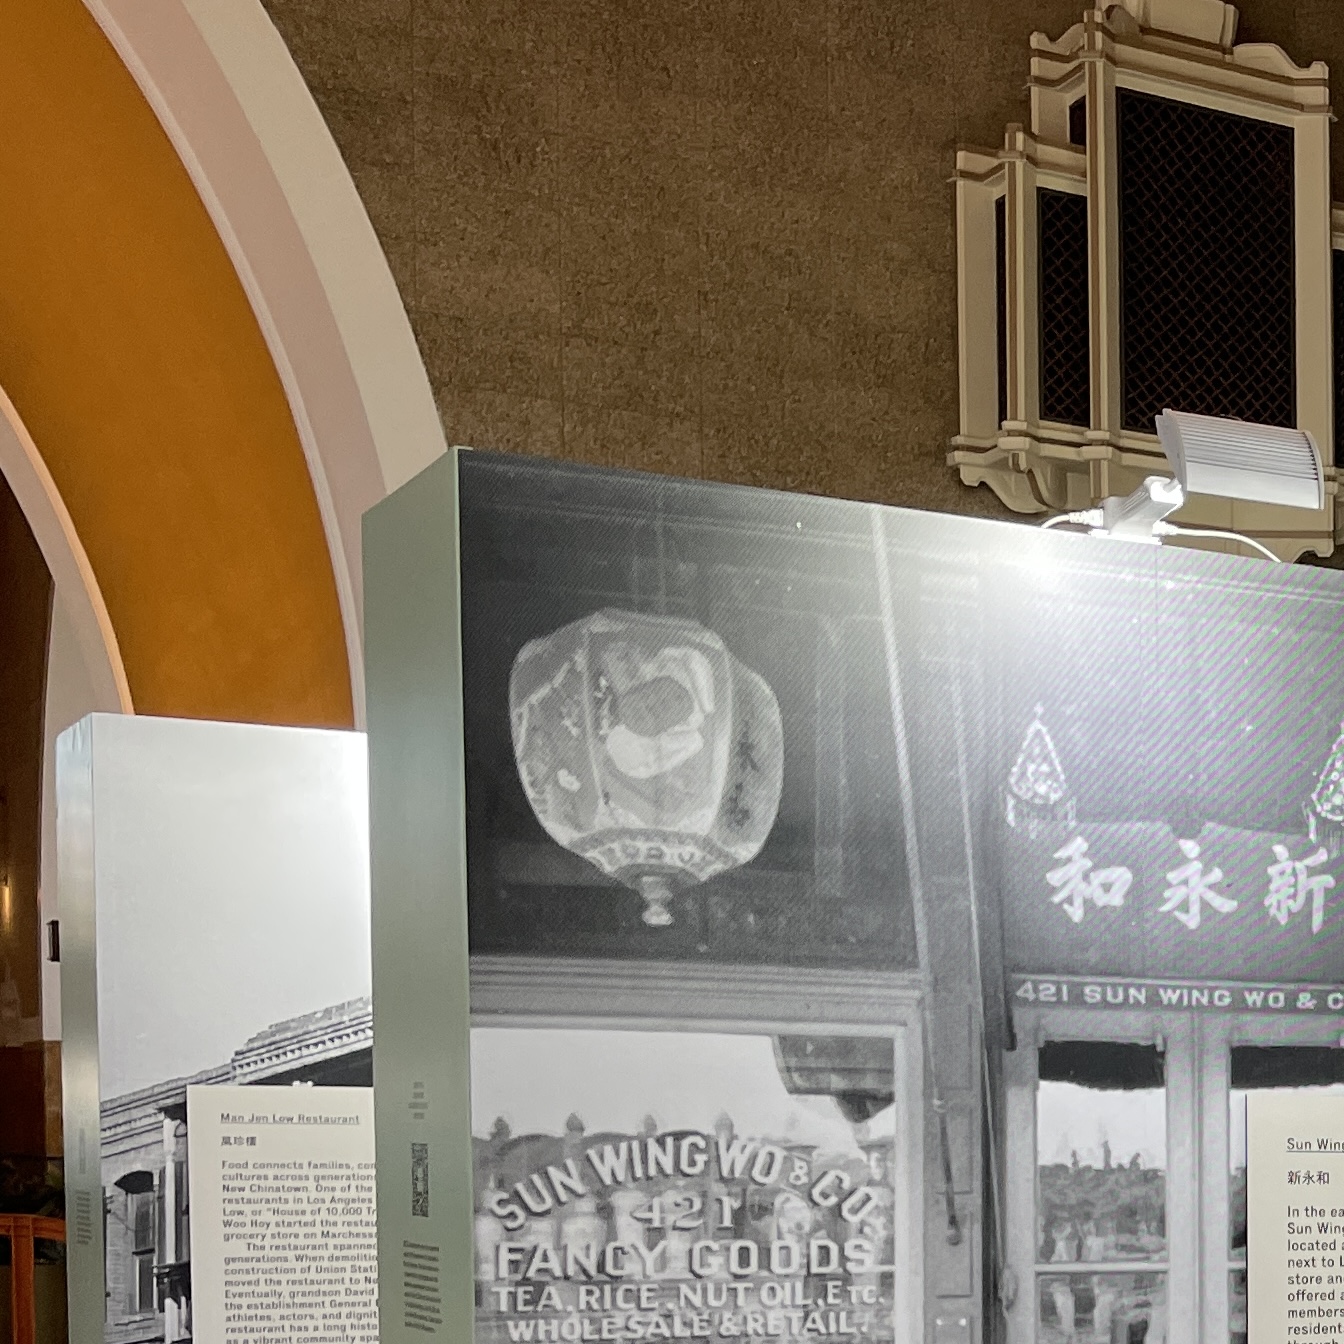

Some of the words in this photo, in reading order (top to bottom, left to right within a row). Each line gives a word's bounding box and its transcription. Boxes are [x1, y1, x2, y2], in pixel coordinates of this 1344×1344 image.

[1016, 980, 1069, 1002] 421
[1084, 983, 1146, 1006] SUN
[1159, 986, 1232, 1008] WING
[1244, 989, 1284, 1009] WO
[1296, 991, 1317, 1010] &
[220, 1113, 244, 1122] Man
[247, 1113, 268, 1122] Jen
[272, 1113, 294, 1122] Low
[297, 1114, 359, 1122] Restaurant
[1286, 1137, 1312, 1150] Sun
[221, 1160, 249, 1169] Food
[252, 1161, 304, 1169] connects
[307, 1160, 354, 1170] families,
[491, 1158, 587, 1231] SUN
[588, 1135, 709, 1187] WING
[716, 1137, 787, 1186] WO
[790, 1158, 809, 1187] &
[1287, 1170, 1330, 1185] 新永和
[222, 1183, 246, 1193] New
[249, 1183, 312, 1193] Chinatown.
[315, 1183, 337, 1193] One
[340, 1183, 351, 1193] of
[355, 1184, 373, 1192] the
[631, 1195, 742, 1231] 421
[1287, 1205, 1300, 1217] In
[1304, 1205, 1326, 1217] the
[1287, 1221, 1312, 1235] Sun
[1287, 1239, 1336, 1251] located
[497, 1239, 668, 1280] FANCY
[690, 1238, 873, 1277] GOODS
[1287, 1256, 1317, 1268] next
[1320, 1256, 1334, 1268] to
[679, 1281, 753, 1307] NUT
[507, 1313, 711, 1342] WHOLESALE
[718, 1312, 744, 1337] &
